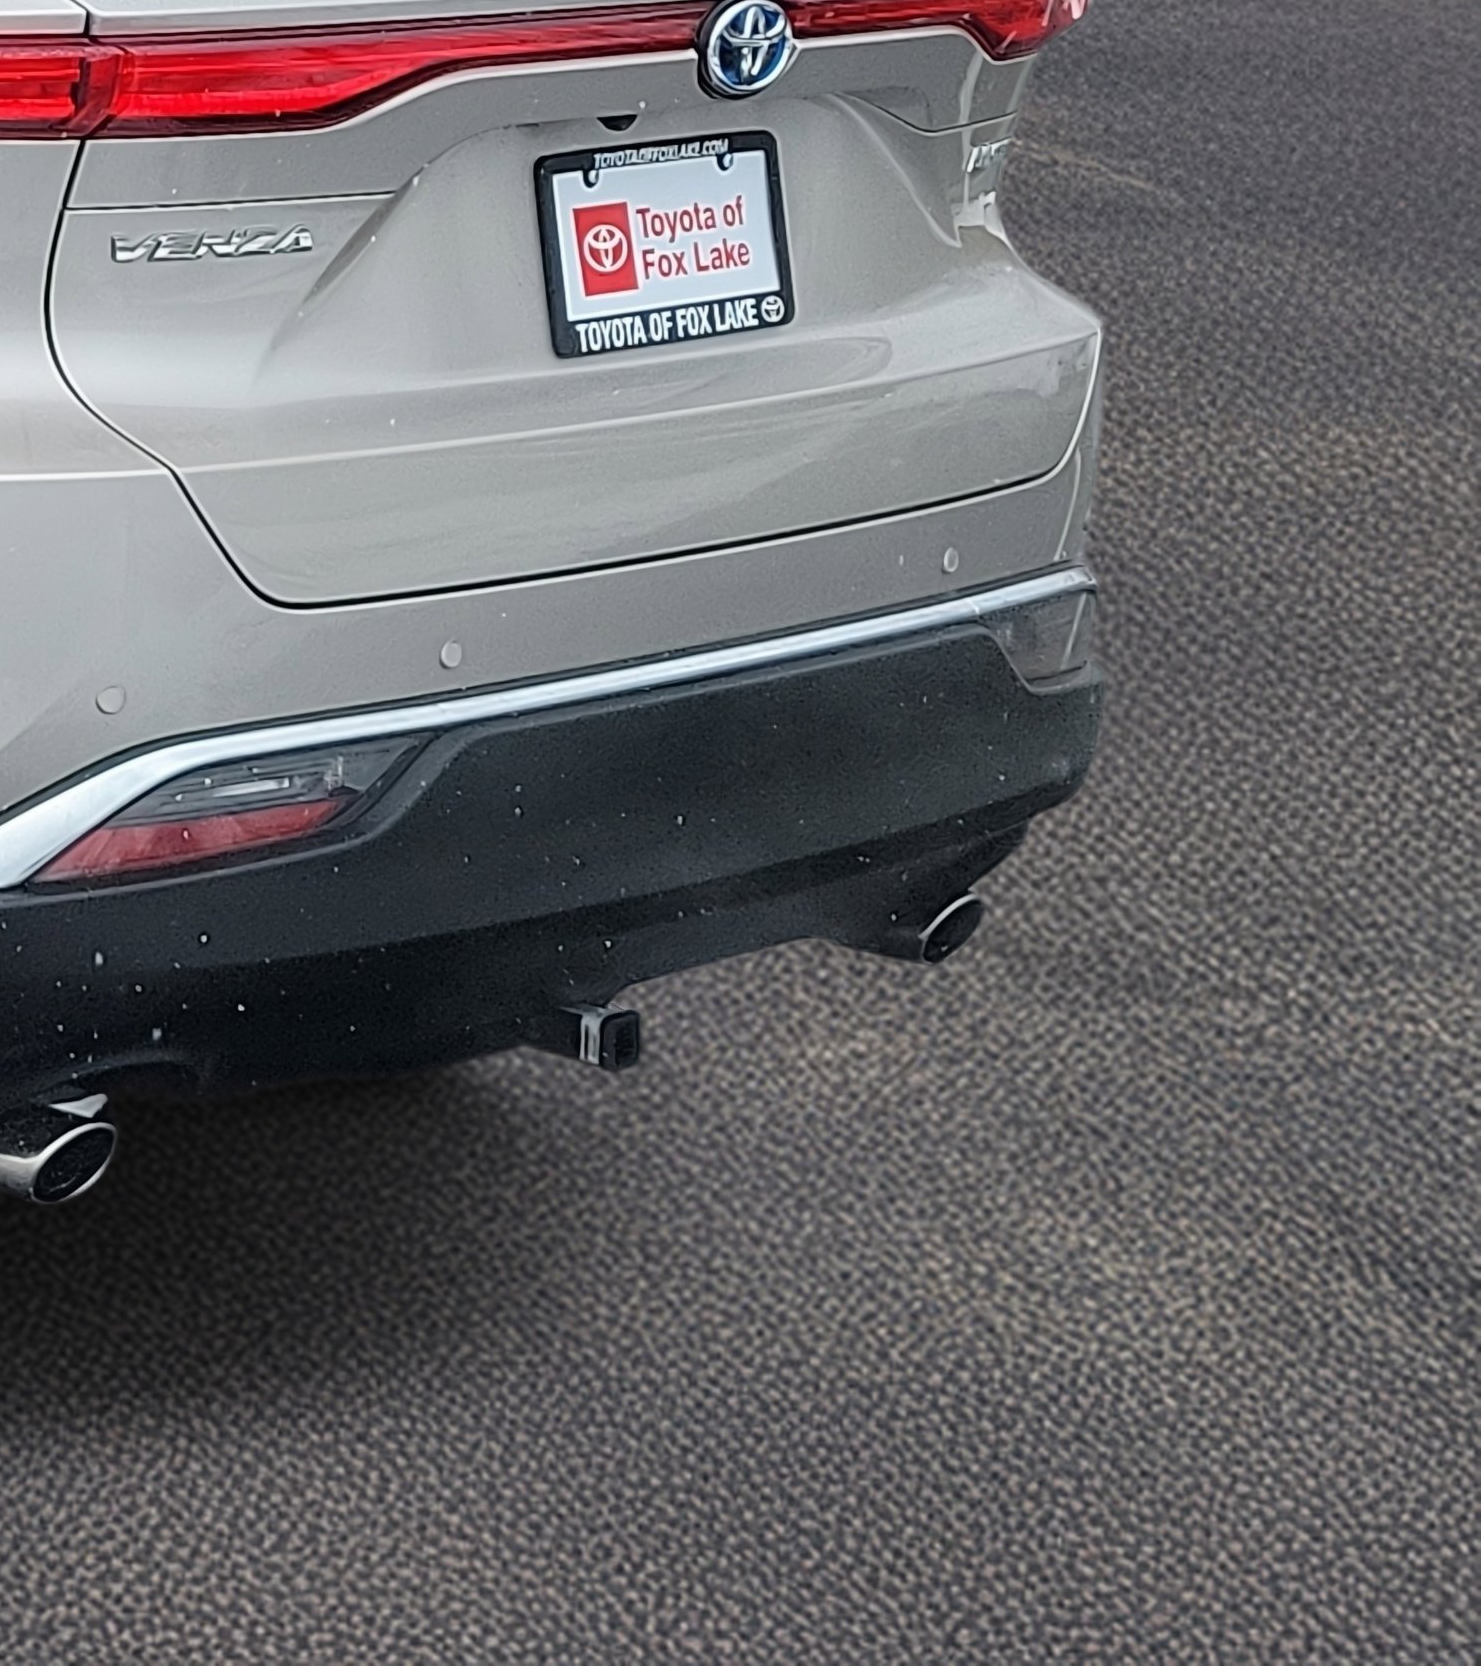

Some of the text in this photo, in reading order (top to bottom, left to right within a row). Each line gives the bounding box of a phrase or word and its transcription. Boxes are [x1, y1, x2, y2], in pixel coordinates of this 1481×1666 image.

[636, 195, 745, 243] Toyota of
[110, 224, 313, 263] VENZA
[642, 238, 751, 280] Fox Lake
[575, 298, 760, 353] TOYOTA OF FOX LAKE
